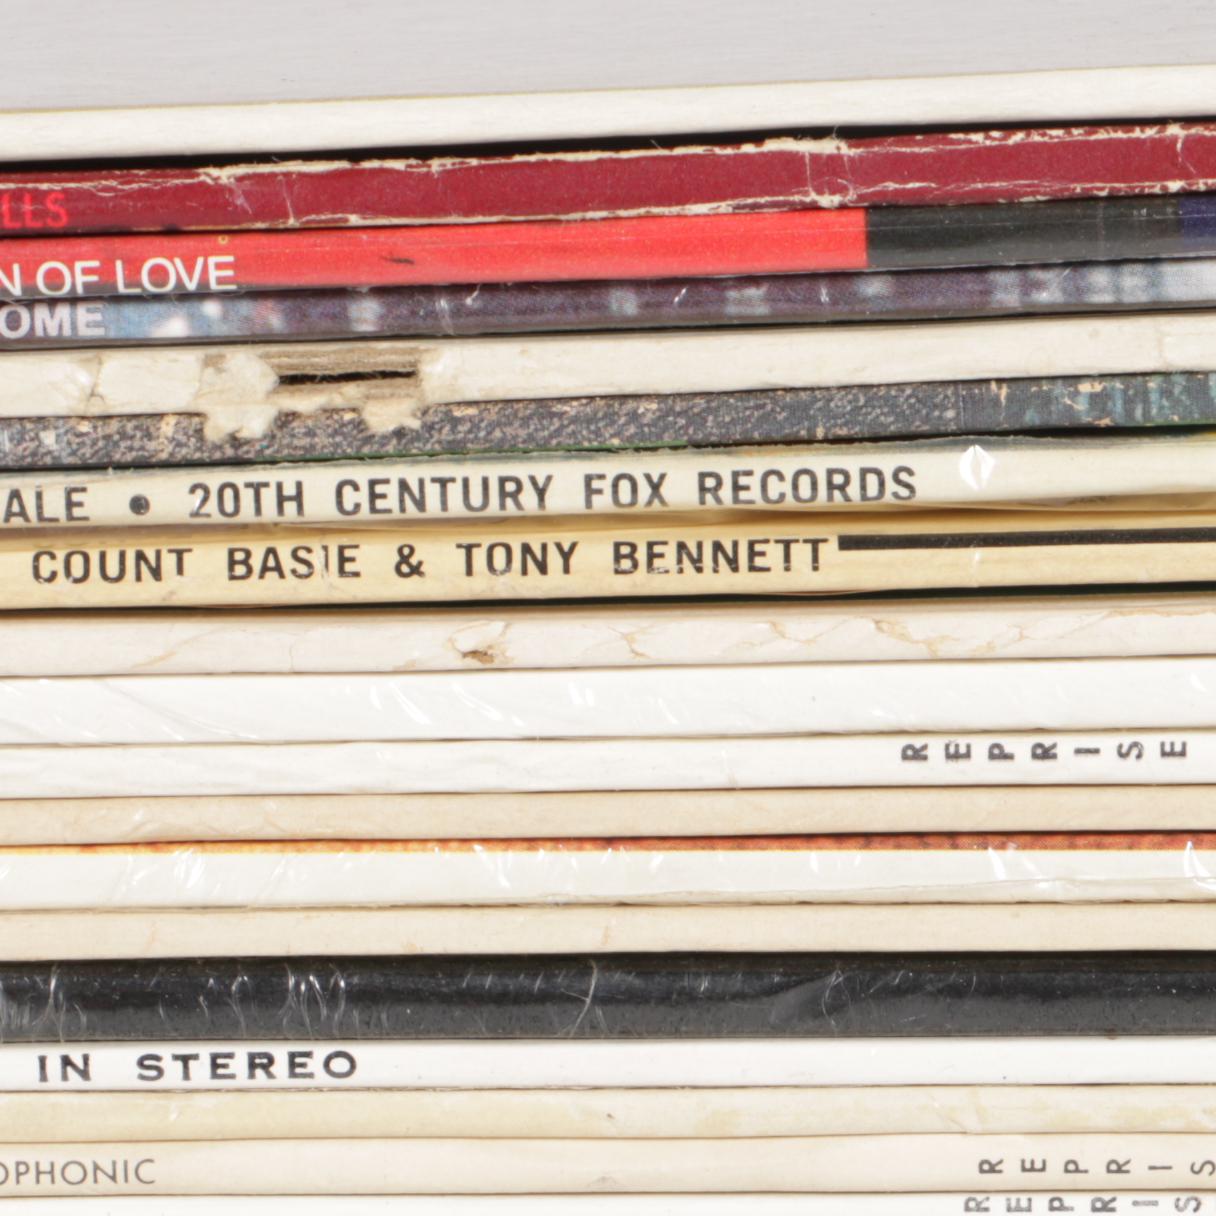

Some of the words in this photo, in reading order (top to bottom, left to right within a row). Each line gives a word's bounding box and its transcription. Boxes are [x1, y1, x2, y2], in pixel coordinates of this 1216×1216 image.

[0, 191, 69, 229] LLS
[36, 260, 100, 295] OF
[115, 255, 238, 293] LOVE
[0, 303, 105, 339] OME
[3, 485, 91, 524] ALE
[188, 481, 305, 519] 20TH
[334, 476, 553, 515] CENTURY
[583, 473, 669, 510] FOX
[697, 467, 918, 508] RECORDS
[32, 547, 193, 585] COUNT
[226, 544, 361, 582] BASIE
[396, 546, 426, 576] &
[455, 541, 580, 579] TONY
[611, 538, 829, 576] BENNETT
[901, 737, 1189, 764] REPRISE
[38, 1053, 93, 1083] IN
[136, 1050, 357, 1082] STEREO
